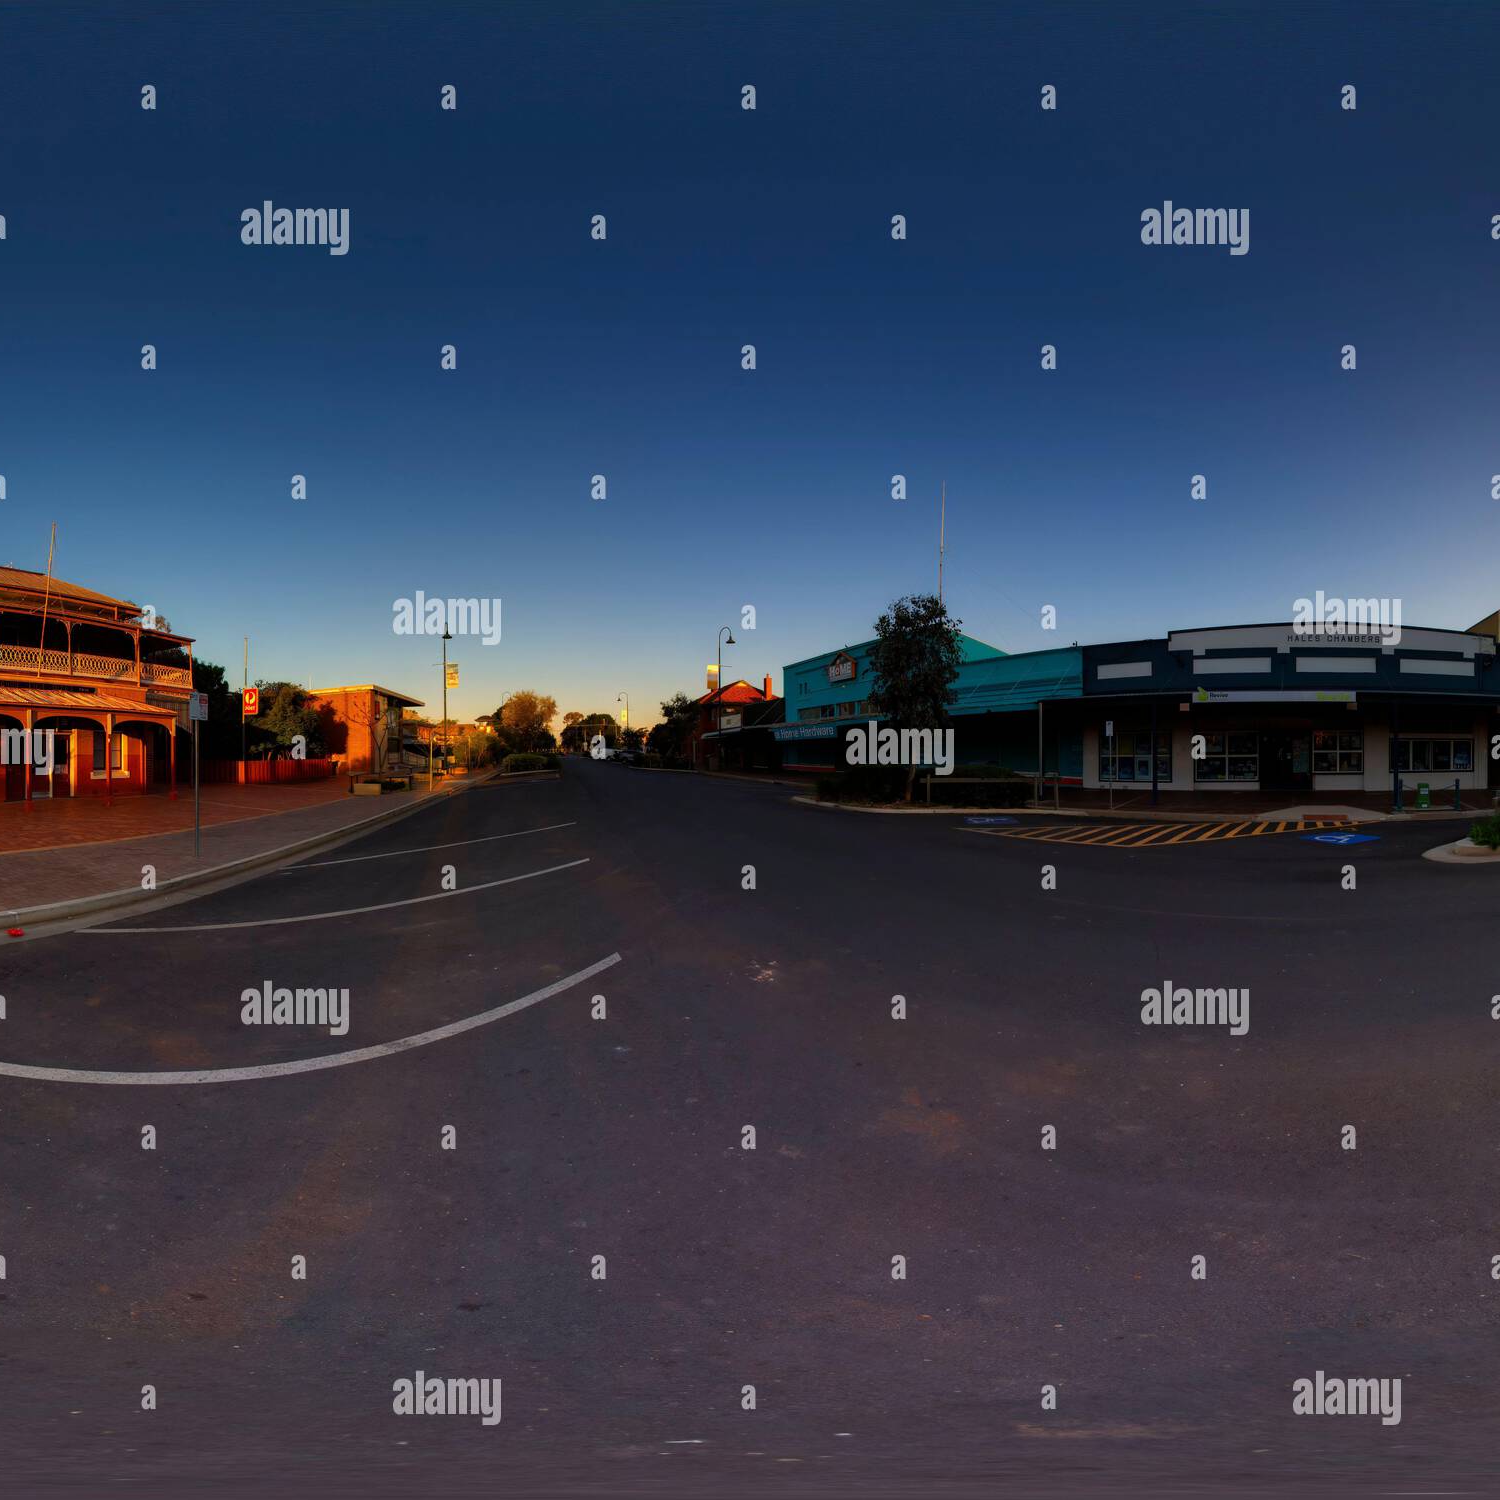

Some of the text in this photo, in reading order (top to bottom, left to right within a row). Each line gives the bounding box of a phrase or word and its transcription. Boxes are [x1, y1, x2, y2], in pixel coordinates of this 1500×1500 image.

[1287, 634, 1380, 643] HALES CHAMBERS
[829, 662, 852, 677] HOME
[800, 726, 834, 738] Hardware
